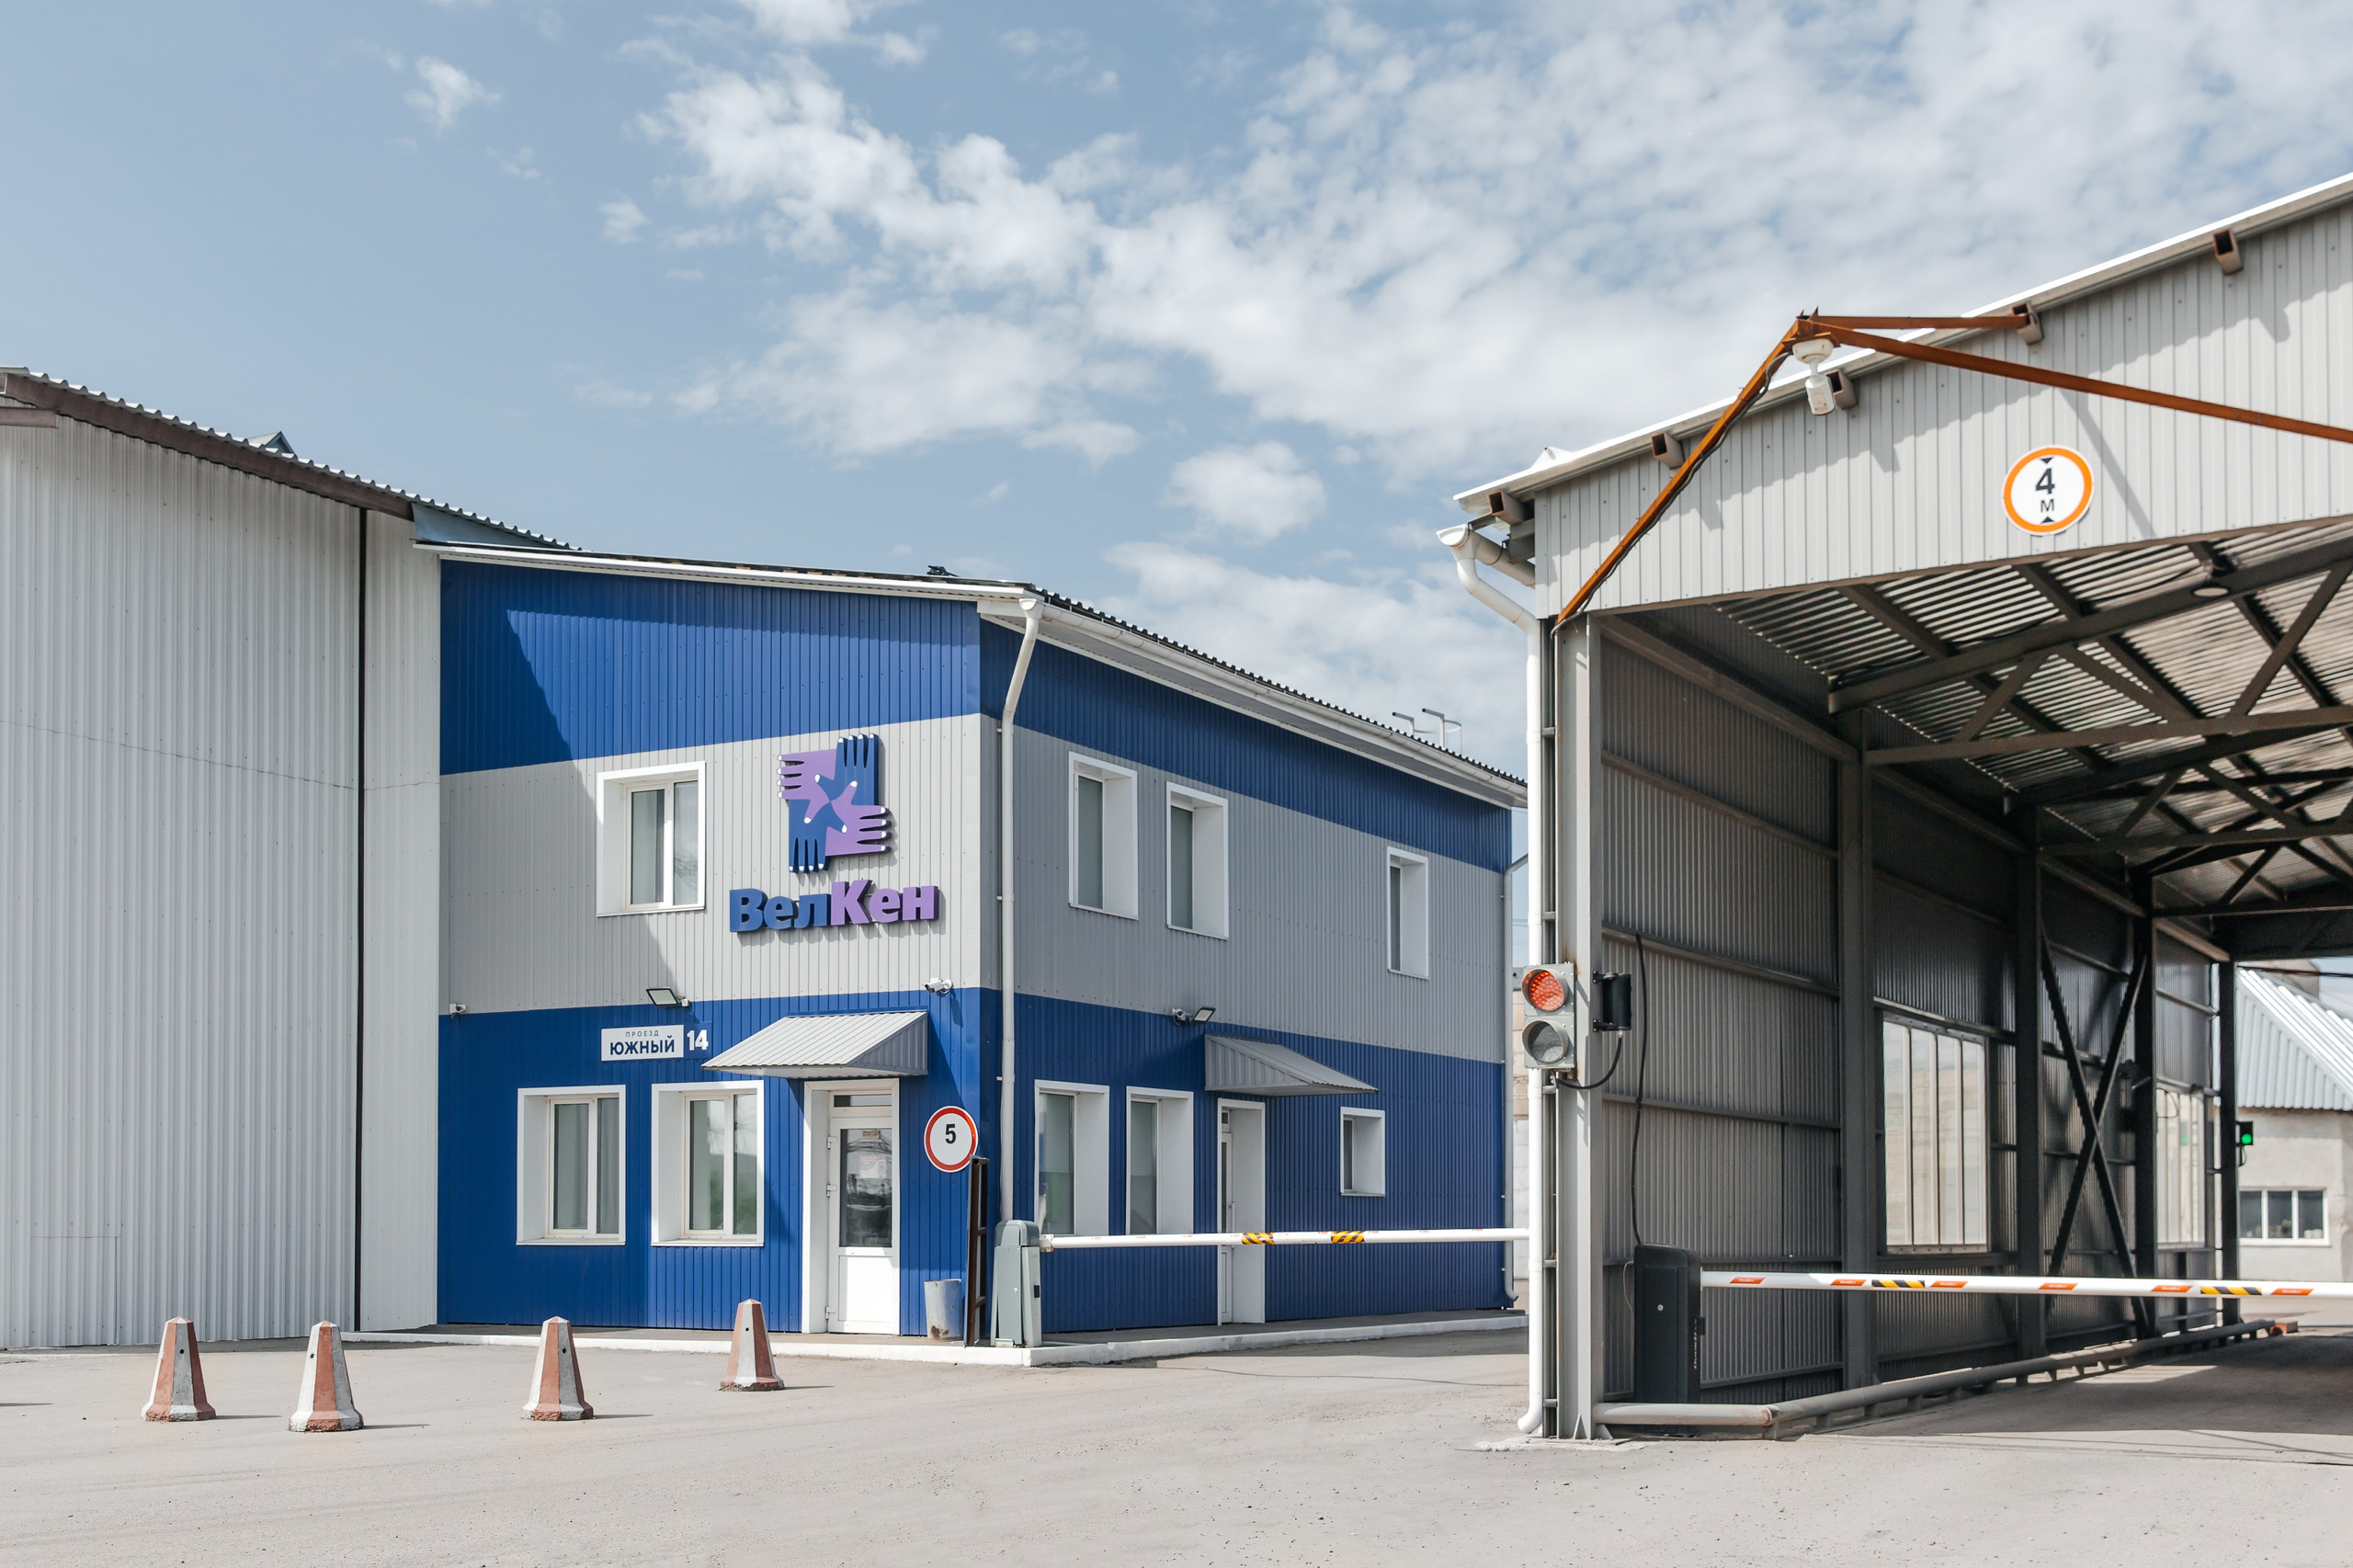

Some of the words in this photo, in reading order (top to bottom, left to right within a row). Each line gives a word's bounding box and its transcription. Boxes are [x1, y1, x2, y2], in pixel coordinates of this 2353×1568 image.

[2034, 467, 2055, 494] 4
[729, 879, 938, 933] ВелКен
[609, 1035, 676, 1056] ЮЖНЫЙ
[687, 1029, 709, 1051] 14
[945, 1123, 957, 1144] 5
